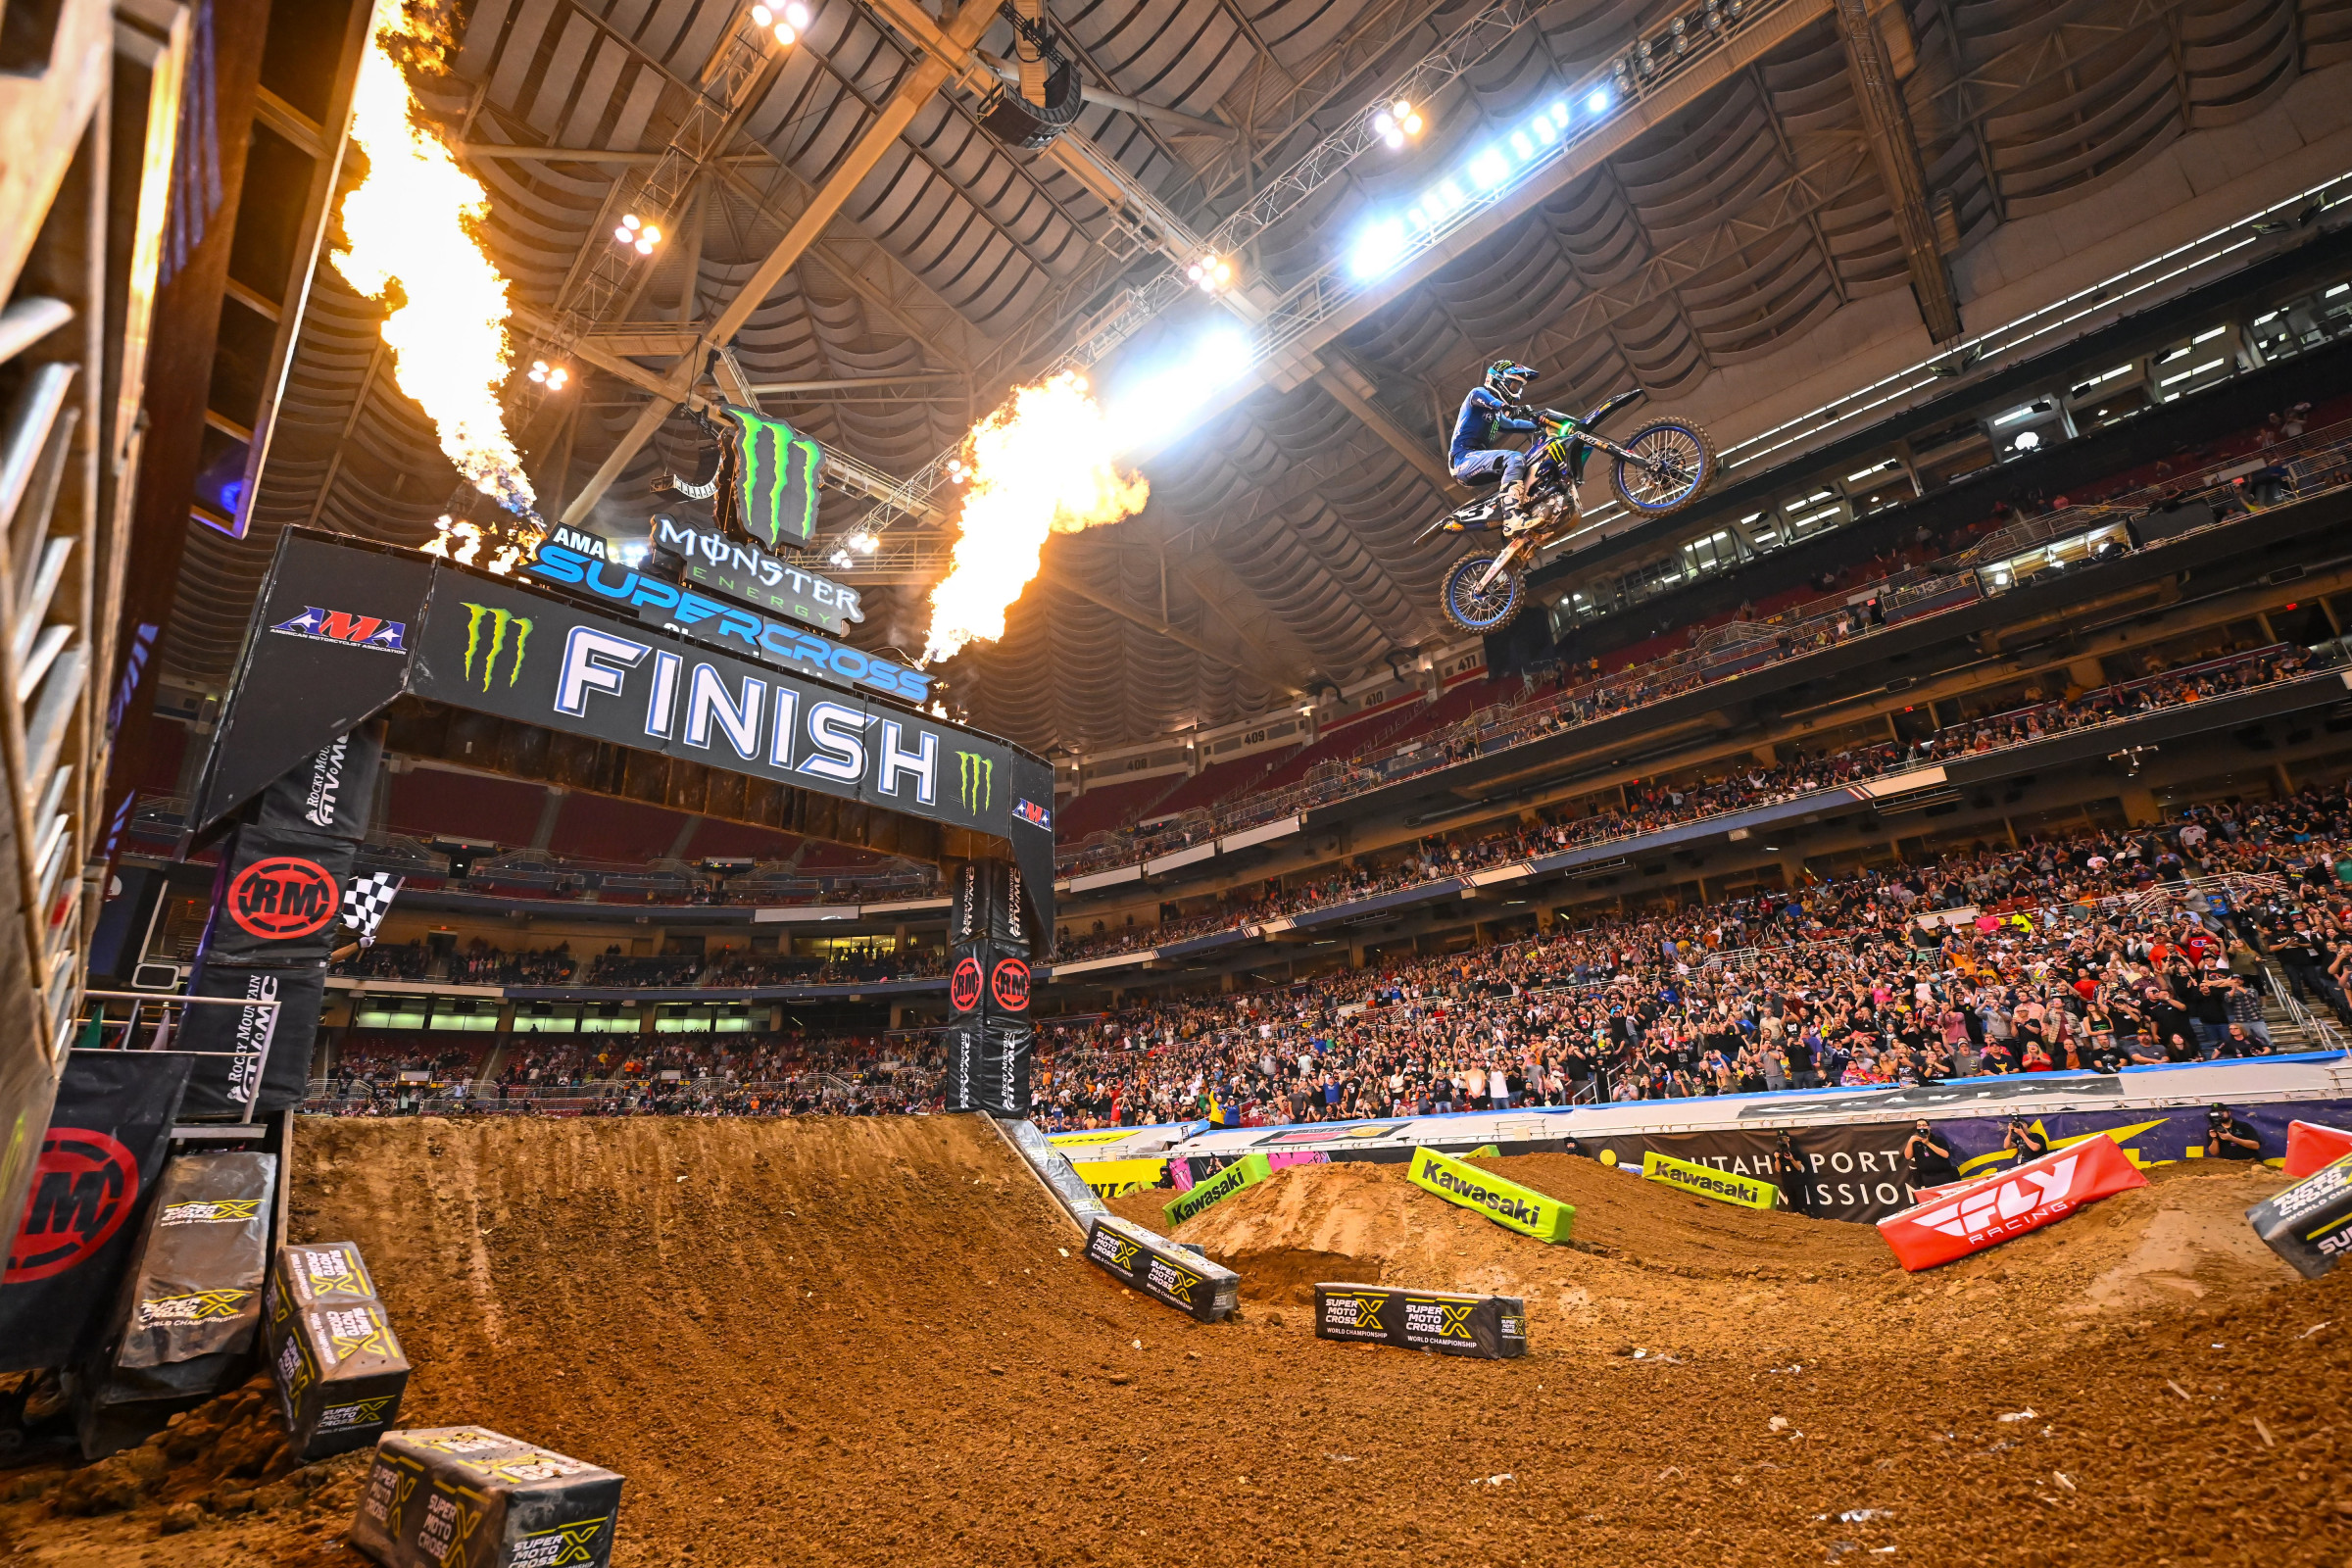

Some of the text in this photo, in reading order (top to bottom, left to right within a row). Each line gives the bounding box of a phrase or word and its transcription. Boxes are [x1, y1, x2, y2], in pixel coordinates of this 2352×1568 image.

[553, 527, 606, 560] AMA
[693, 565, 831, 624] ENERGY
[270, 605, 408, 651] AMA
[529, 545, 929, 703] SUPERCROSS
[270, 628, 407, 656] AMERICAN MOTORCYCLIST ASSOCIATION
[1458, 655, 1476, 670] 411
[1365, 691, 1383, 707] 410
[554, 625, 939, 806] FINISH
[1244, 730, 1264, 745] 409
[306, 772, 324, 808] ROCKY
[1012, 797, 1052, 829] AMA
[248, 876, 319, 918] RM
[1803, 1151, 1918, 1174] PORT
[1654, 1160, 1759, 1202] Kawasaki
[1172, 1166, 1245, 1225] Kawasaki
[1421, 1158, 1541, 1228] Kawasaki
[1911, 1154, 2079, 1237] FLY
[1969, 1201, 2068, 1245] RACING
[1096, 1230, 1120, 1247] SUPER
[1096, 1238, 1117, 1253] MOTO
[1092, 1244, 1116, 1259] CROSS
[1150, 1260, 1177, 1278] SUPER
[1151, 1267, 1175, 1285] MOTO
[1148, 1273, 1173, 1292] CROSS
[1325, 1298, 1358, 1308] SUPER
[1327, 1306, 1357, 1316] MOTO
[1405, 1304, 1443, 1315] SUPER
[1325, 1314, 1357, 1325] CROSS
[1408, 1313, 1442, 1323] MOTO
[1346, 1329, 1388, 1339] CHAMPIONSHIP
[1405, 1322, 1443, 1333] CROSS
[1429, 1337, 1477, 1348] CHAMPIONSHIP
[427, 1494, 457, 1522] SUPER
[422, 1513, 452, 1541] MOTO
[417, 1531, 449, 1560] CROSS
[512, 1535, 564, 1552] SUPER
[513, 1544, 559, 1561] MOTO
[508, 1554, 558, 1568] CROSS
